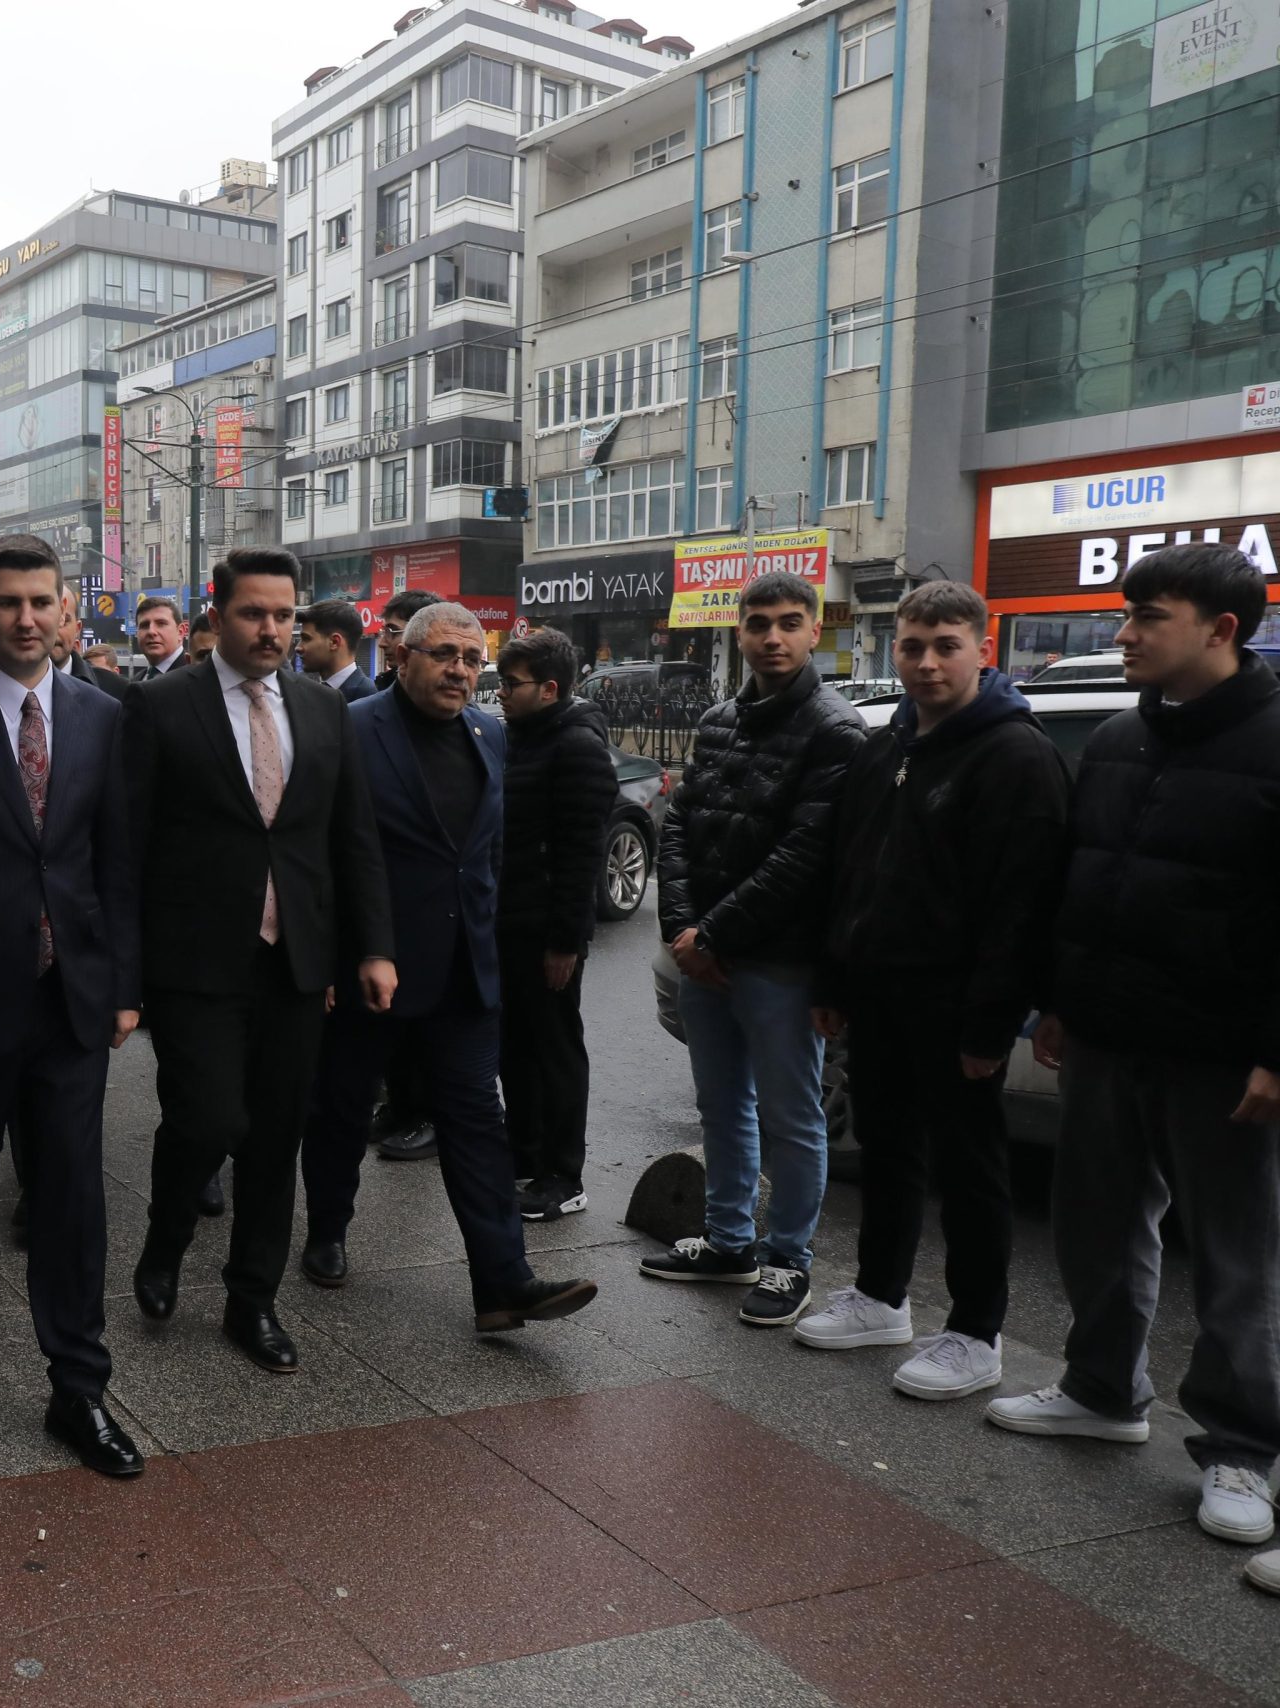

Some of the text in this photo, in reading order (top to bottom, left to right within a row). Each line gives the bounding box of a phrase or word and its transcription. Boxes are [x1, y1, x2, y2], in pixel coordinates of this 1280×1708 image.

[1179, 20, 1242, 56] EVENT
[17, 239, 40, 265] YAPI
[217, 411, 240, 422] ÖZDE
[221, 443, 236, 456] 12
[317, 439, 370, 466] KAYRAN
[107, 418, 117, 508] SÜRÜCÜ
[1087, 475, 1166, 509] UĞUR
[684, 544, 717, 555] KENTSEL
[784, 536, 817, 546] DOLAYI
[1078, 523, 1279, 586] BEA
[521, 571, 664, 605] bambi YATAK
[701, 592, 741, 607] ZARA
[678, 611, 739, 625] SATIŞLARIMI
